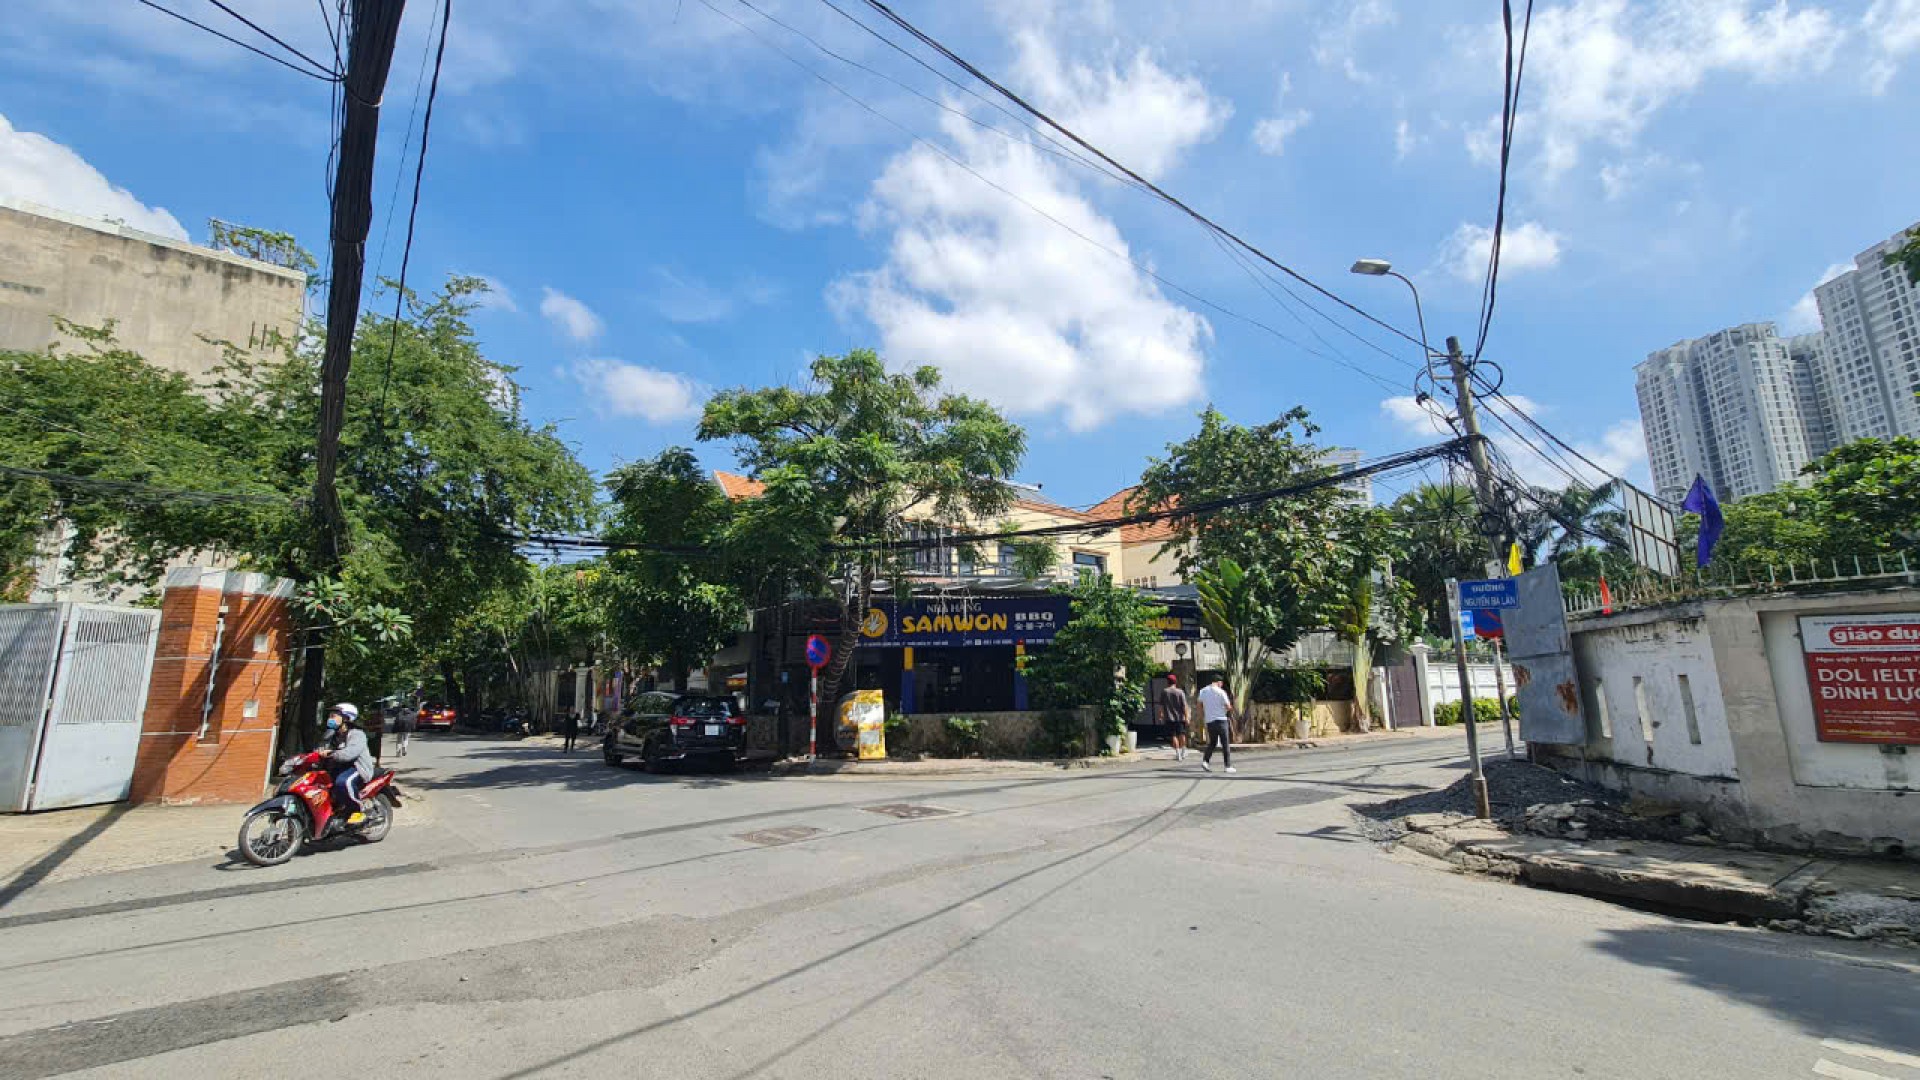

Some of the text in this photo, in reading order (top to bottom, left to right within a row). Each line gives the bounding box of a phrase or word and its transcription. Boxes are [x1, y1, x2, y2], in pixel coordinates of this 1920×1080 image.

[901, 613, 1008, 633] SAMWON
[1014, 611, 1054, 621] BBQ
[1887, 626, 1920, 642] dụ
[1817, 668, 1920, 682] DOL IELT
[1820, 682, 1879, 700] ĐÌNH
